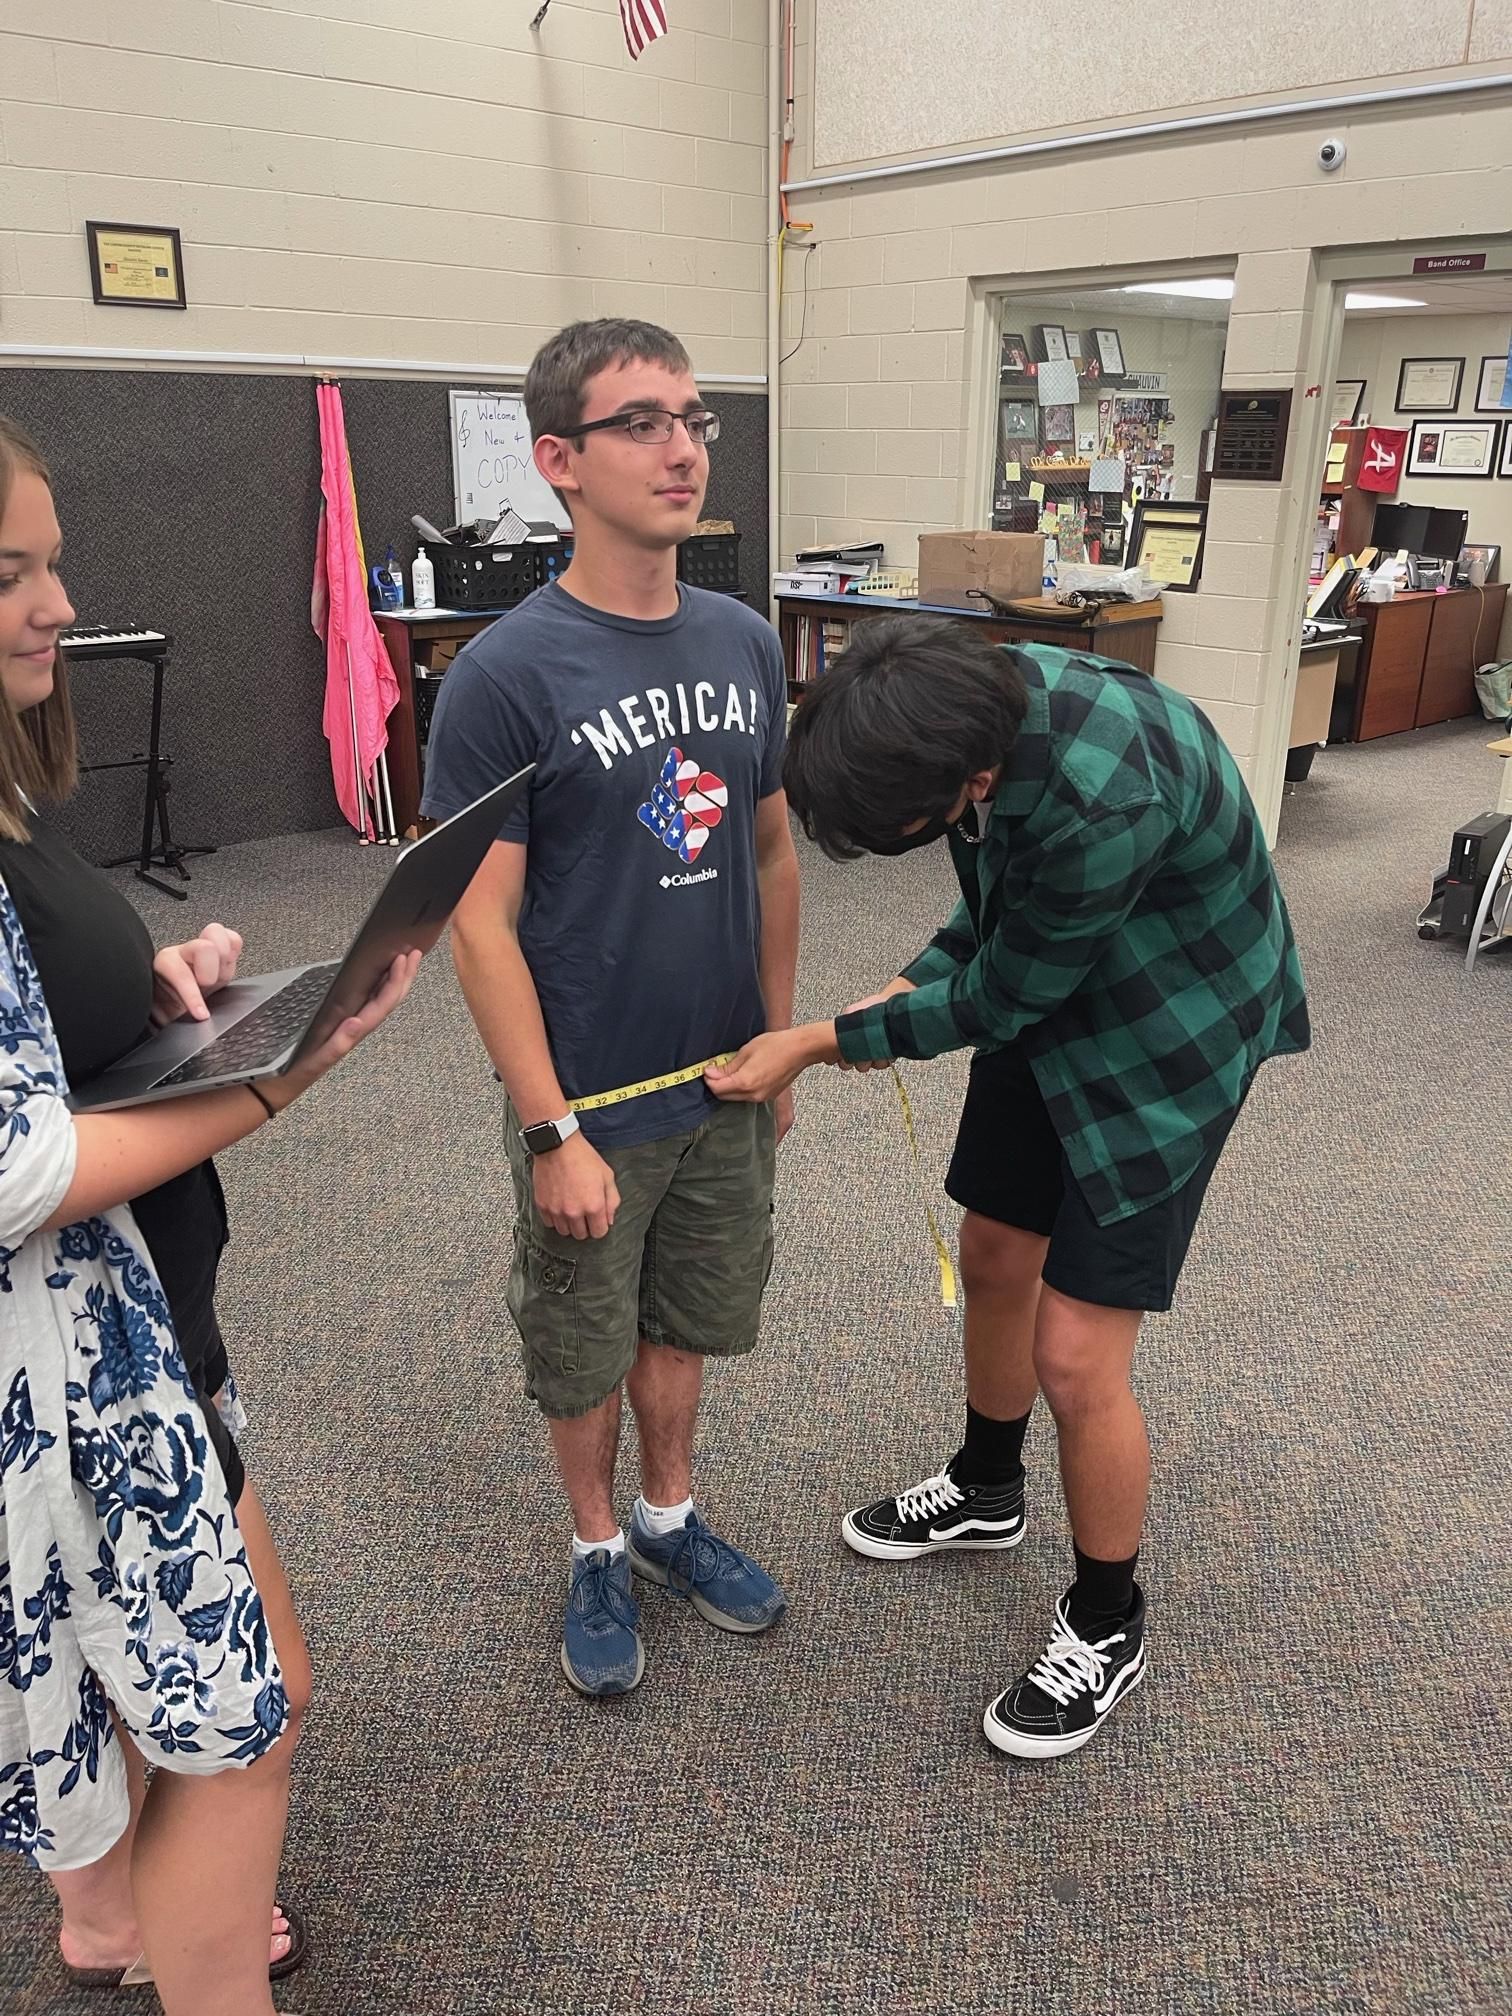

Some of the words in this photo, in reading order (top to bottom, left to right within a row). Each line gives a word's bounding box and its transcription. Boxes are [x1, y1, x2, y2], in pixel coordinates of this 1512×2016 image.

[1448, 259, 1471, 267] Office
[477, 403, 516, 421] Welcome
[484, 429, 505, 446] New
[477, 454, 532, 488] COPY
[671, 867, 718, 886] Columbia
[573, 1101, 586, 1111] 31
[595, 1096, 608, 1107] 32
[615, 1091, 628, 1101] 33
[635, 1085, 648, 1095] 34
[654, 1079, 667, 1089] 35
[674, 1073, 686, 1084] 36
[691, 1067, 701, 1078] 37
